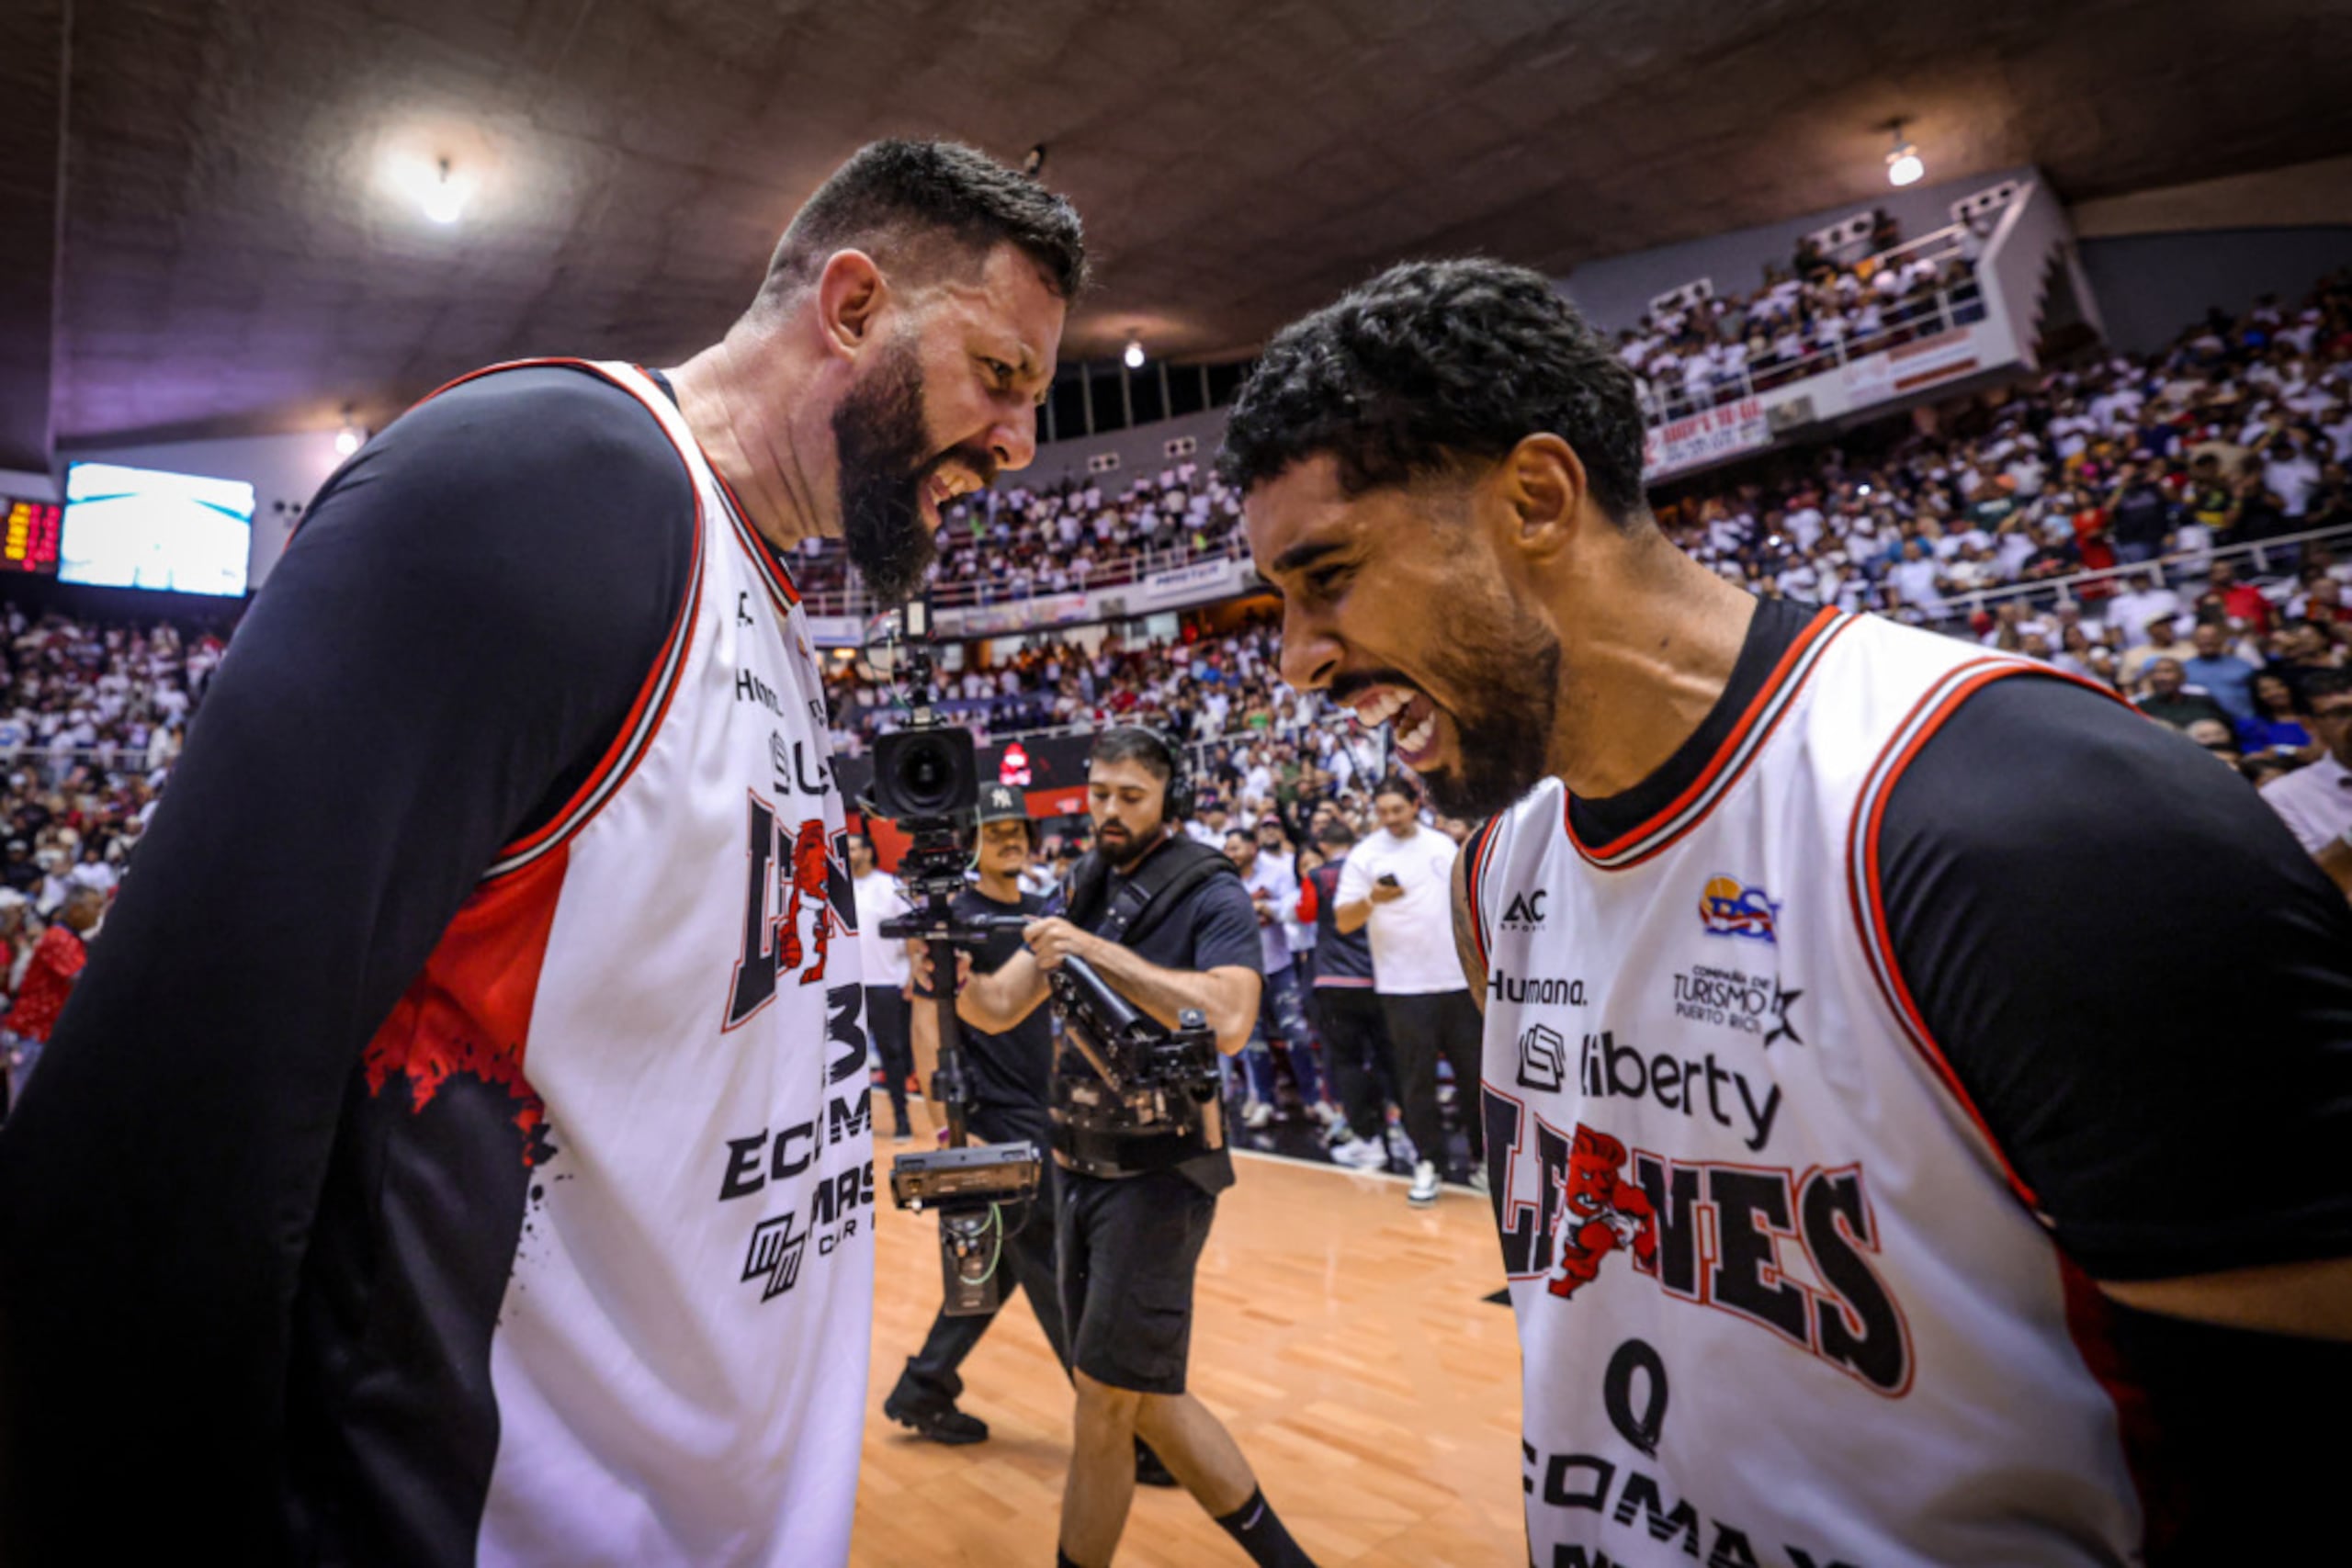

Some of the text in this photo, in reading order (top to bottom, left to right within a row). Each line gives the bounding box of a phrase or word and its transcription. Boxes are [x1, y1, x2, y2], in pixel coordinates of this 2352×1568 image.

[1502, 889, 1547, 923] AC
[1674, 974, 1766, 1016] TURISMO
[1676, 1002, 1724, 1025] PUERTO
